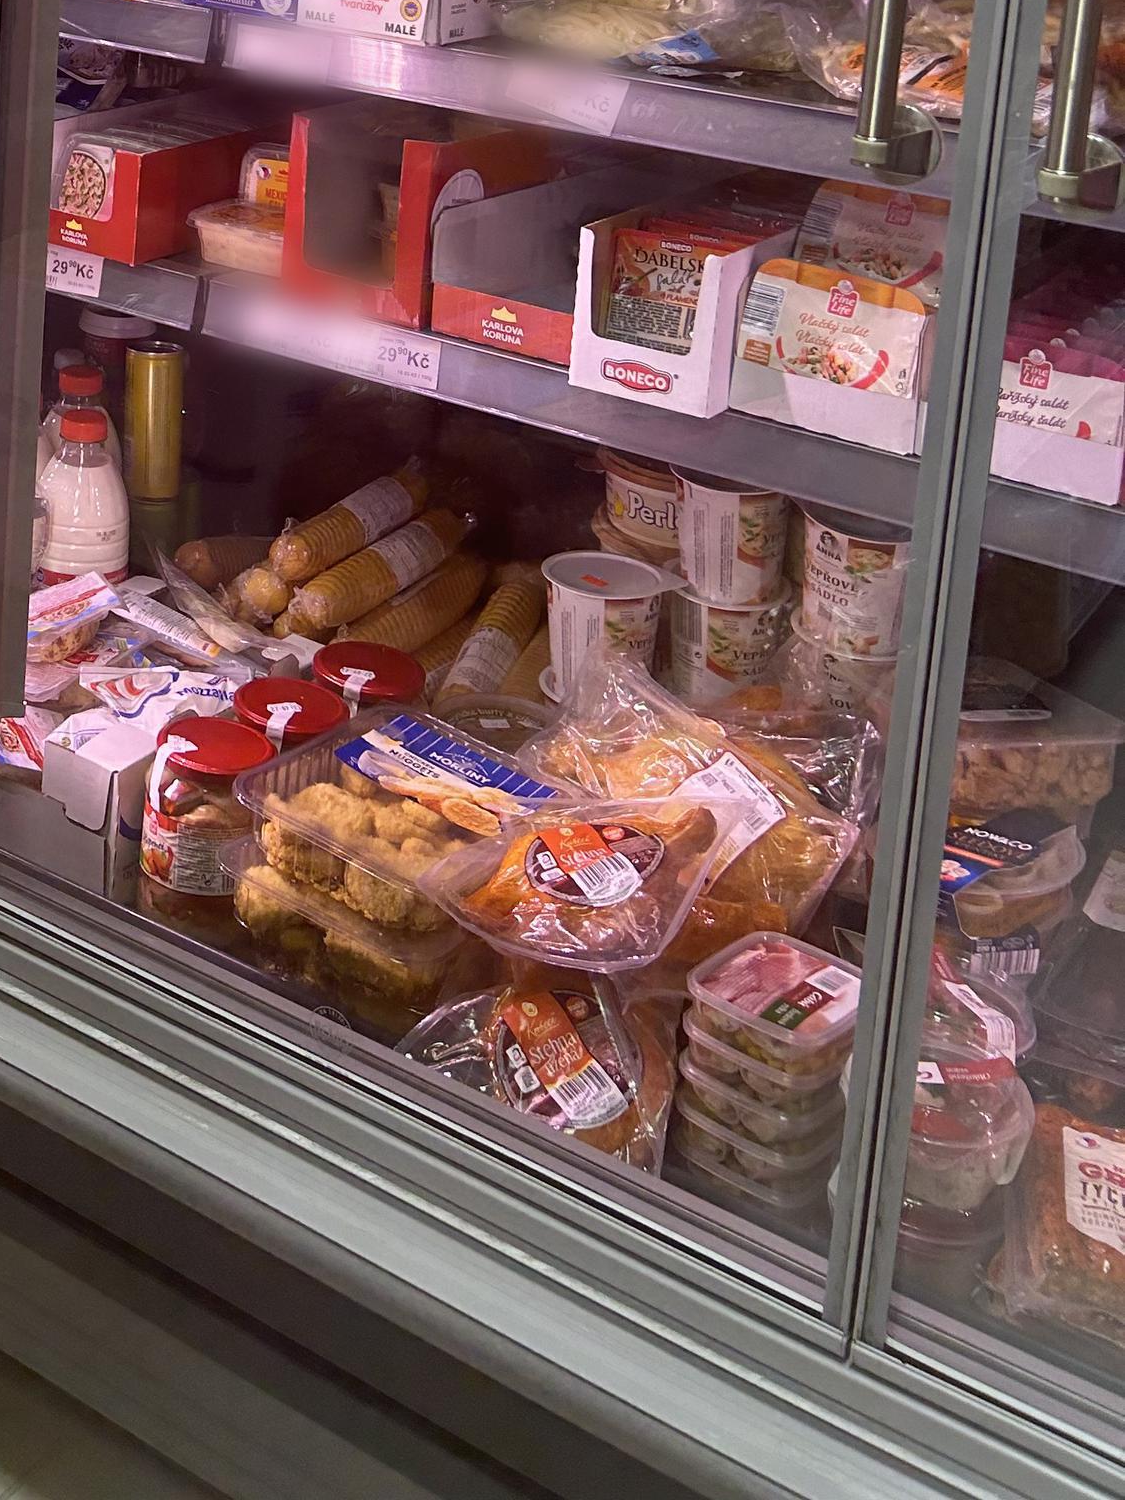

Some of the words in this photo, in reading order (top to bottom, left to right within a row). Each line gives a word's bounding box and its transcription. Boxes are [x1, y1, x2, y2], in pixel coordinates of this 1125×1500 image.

[305, 9, 336, 24] MALÉ
[385, 18, 416, 37] MALÉ
[661, 240, 692, 253] BONECO
[832, 292, 856, 307] Fine
[831, 302, 853, 316] Life
[482, 319, 523, 337] KARLOVA
[483, 329, 522, 346] KORUNA
[407, 350, 430, 369] Kč
[605, 364, 667, 390] BONECO
[1023, 363, 1049, 377] Fine
[1023, 372, 1046, 387] Life
[1040, 396, 1069, 411] salát
[815, 543, 842, 563] ANNA
[810, 584, 849, 607] SÁDLO
[389, 749, 440, 779] NUGGETS
[429, 750, 492, 785] MORLINY
[964, 827, 1033, 851] NOWACO
[529, 1031, 578, 1065] Stehna
